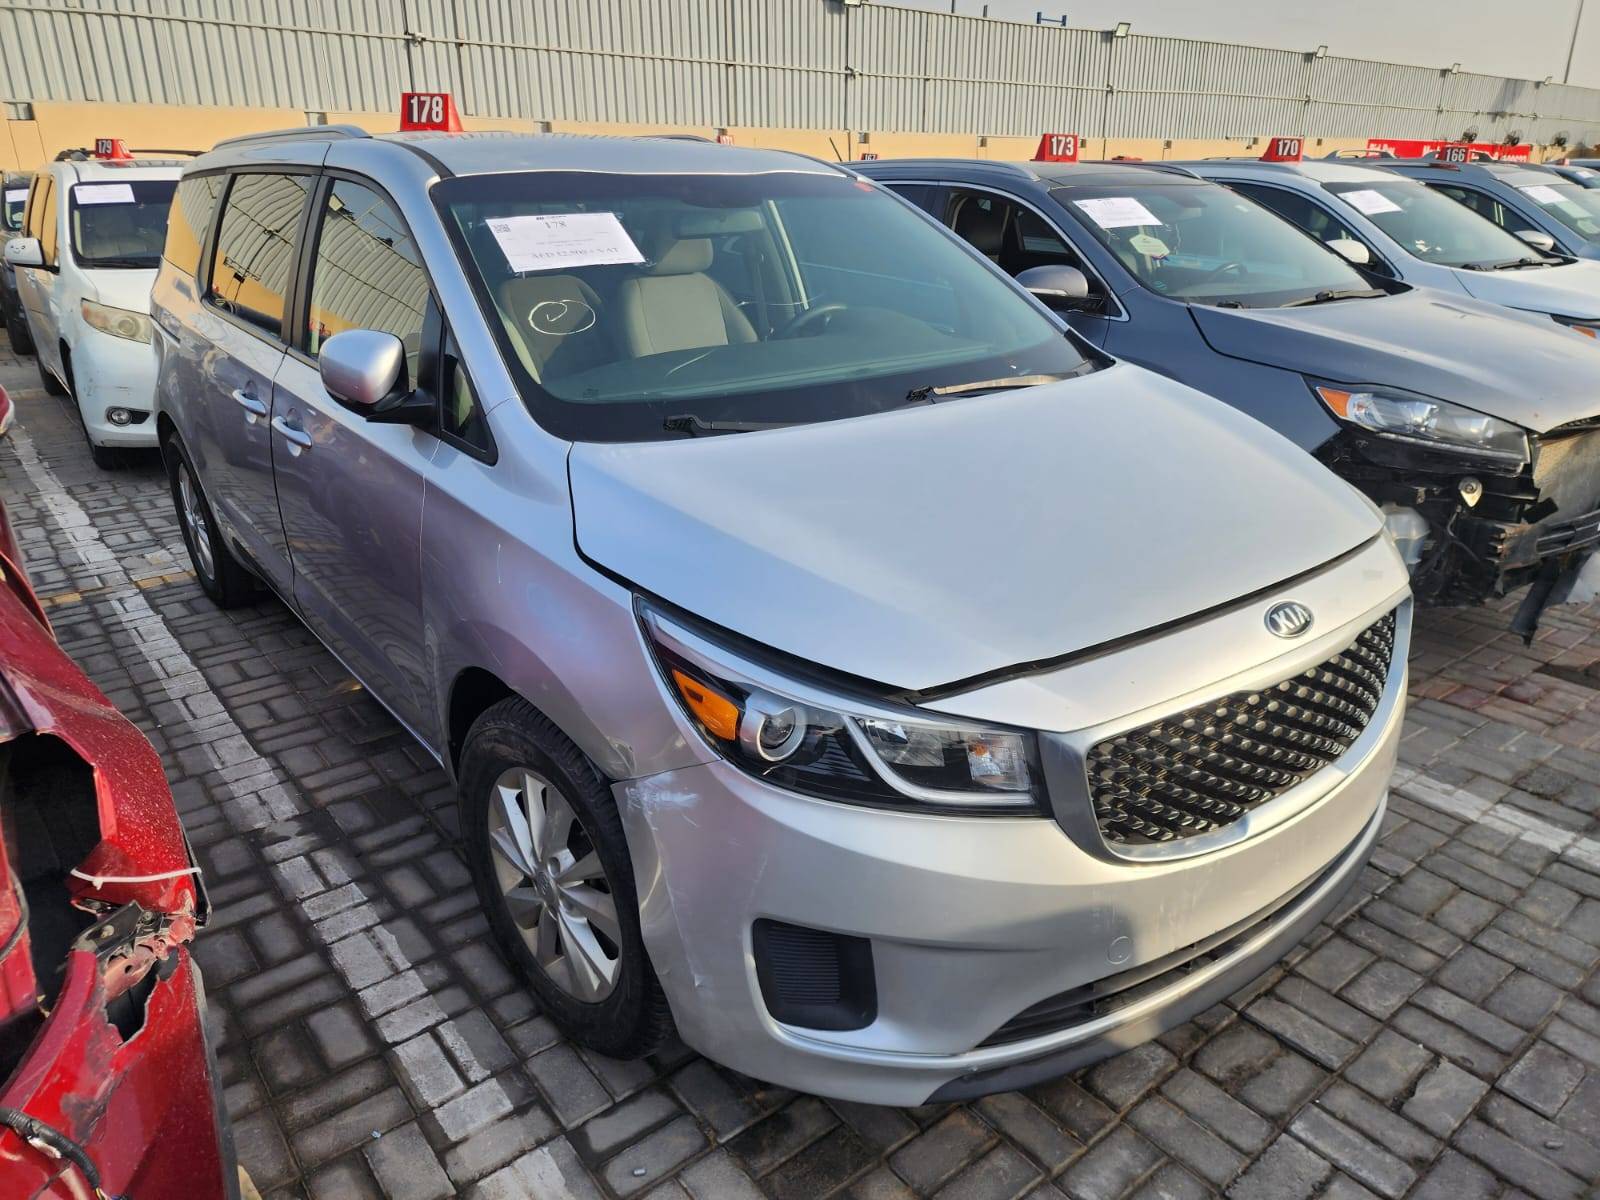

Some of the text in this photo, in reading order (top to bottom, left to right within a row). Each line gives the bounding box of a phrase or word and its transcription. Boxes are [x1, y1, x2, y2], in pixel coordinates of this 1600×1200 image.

[410, 95, 443, 123] 178
[98, 140, 112, 154] 179
[1051, 136, 1074, 156] 173
[1278, 139, 1299, 156] 170
[1446, 148, 1466, 162] 166
[545, 220, 568, 230] 178
[1270, 604, 1310, 634] KIA
